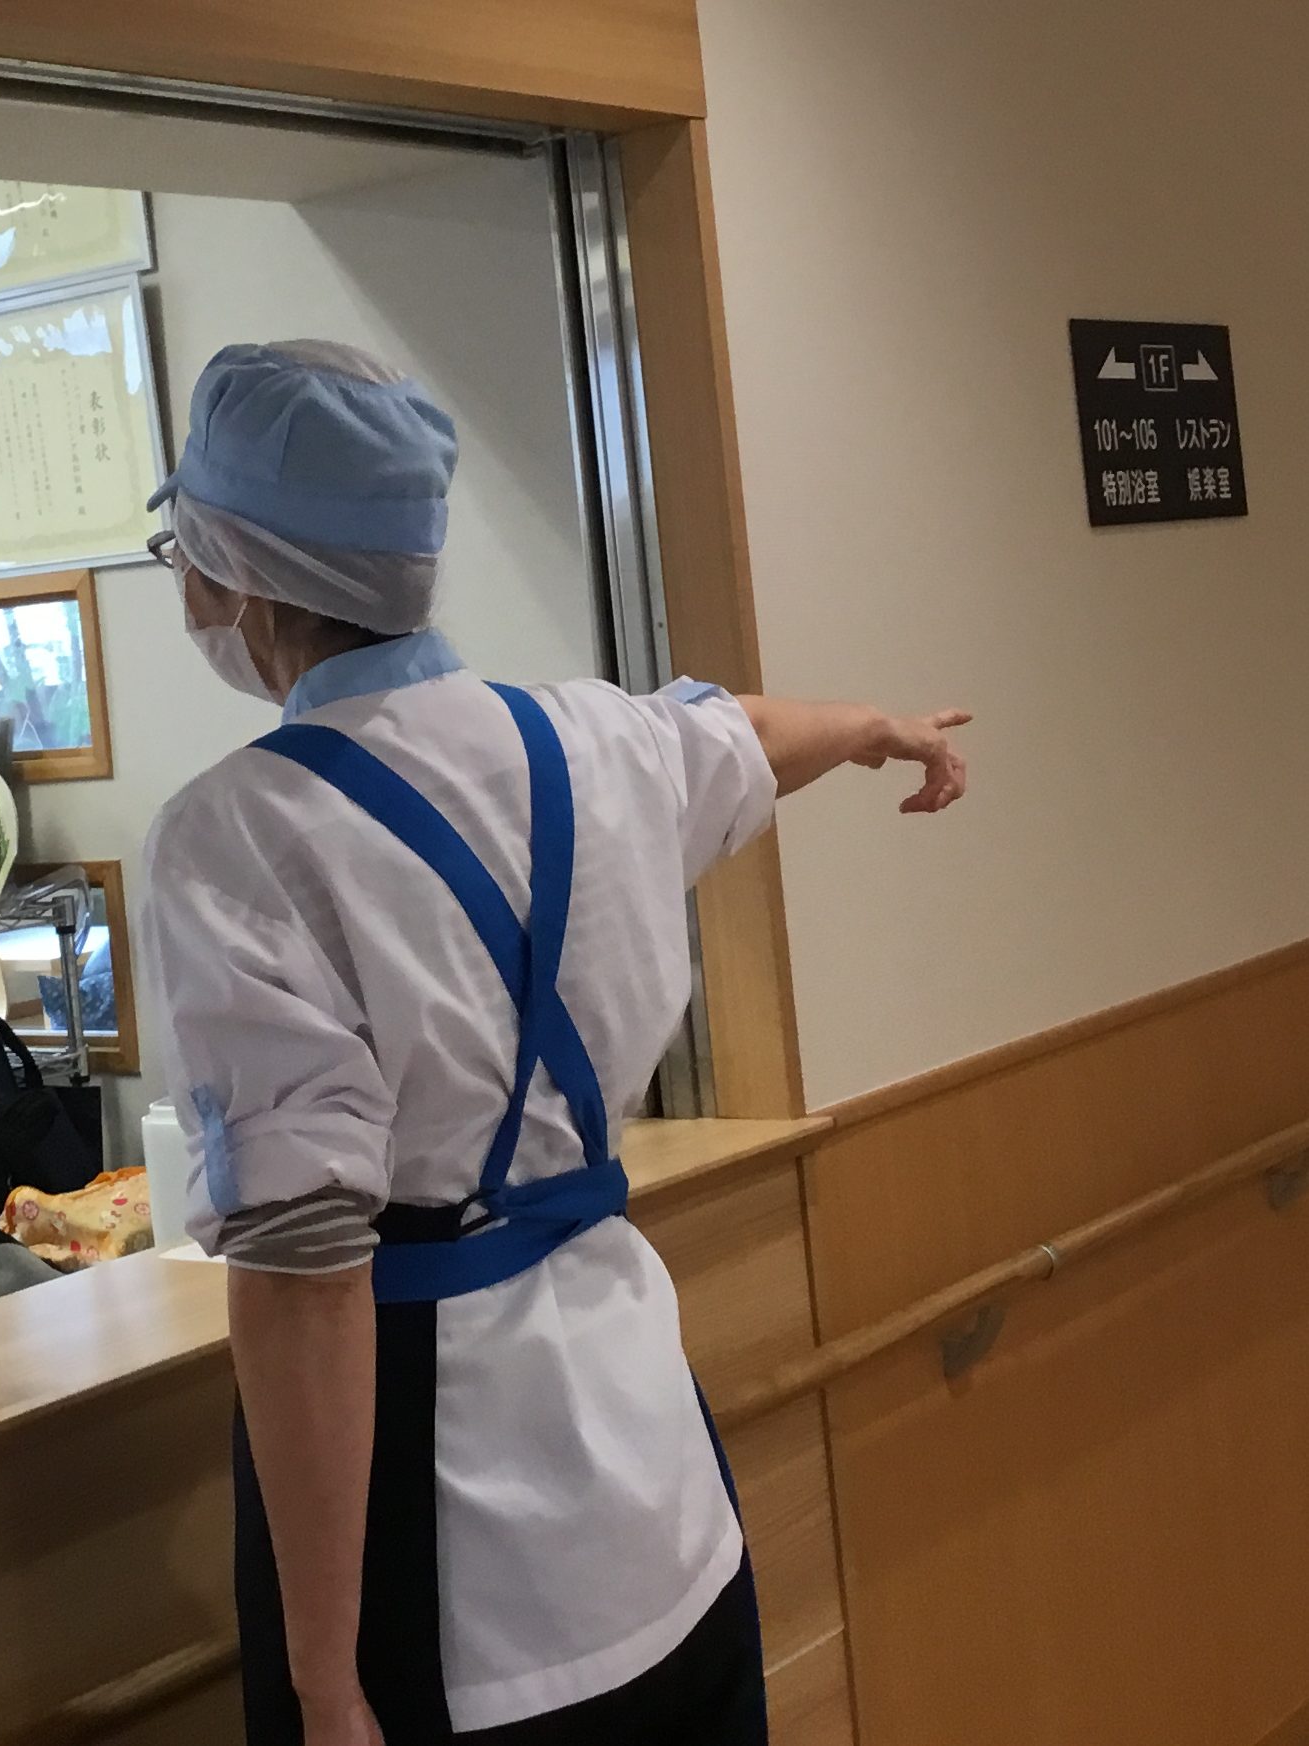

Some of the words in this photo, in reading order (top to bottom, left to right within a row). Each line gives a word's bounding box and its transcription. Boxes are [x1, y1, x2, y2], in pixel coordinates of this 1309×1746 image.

[1148, 353, 1170, 384] 1F
[1175, 417, 1231, 449] レストラン
[1101, 468, 1161, 506] 特別浴室
